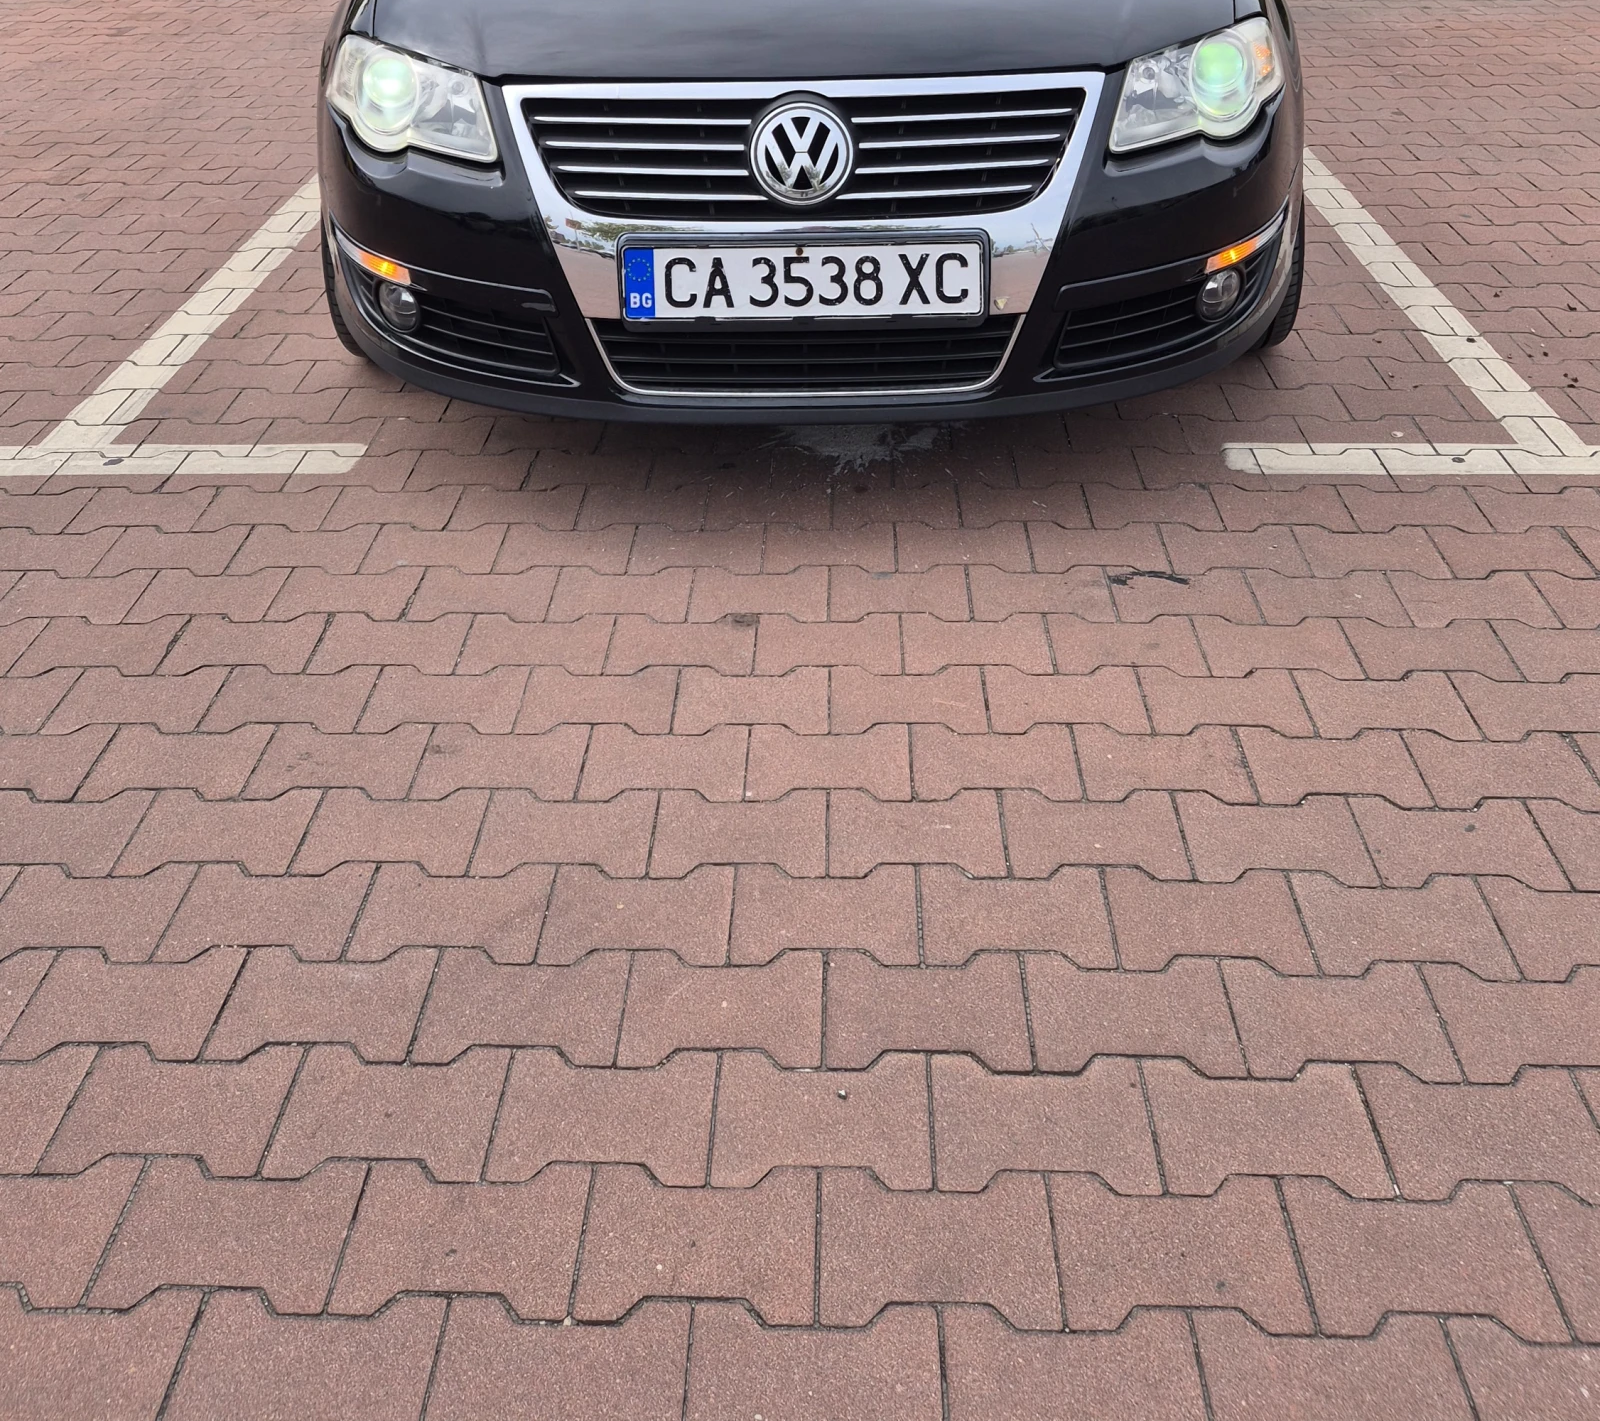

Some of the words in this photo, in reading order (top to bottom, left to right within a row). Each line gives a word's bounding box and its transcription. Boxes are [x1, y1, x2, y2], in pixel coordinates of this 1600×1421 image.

[757, 109, 846, 198] VW
[630, 292, 652, 308] BG
[664, 257, 735, 308] CA
[749, 255, 883, 307] 3538
[898, 253, 969, 305] XC
